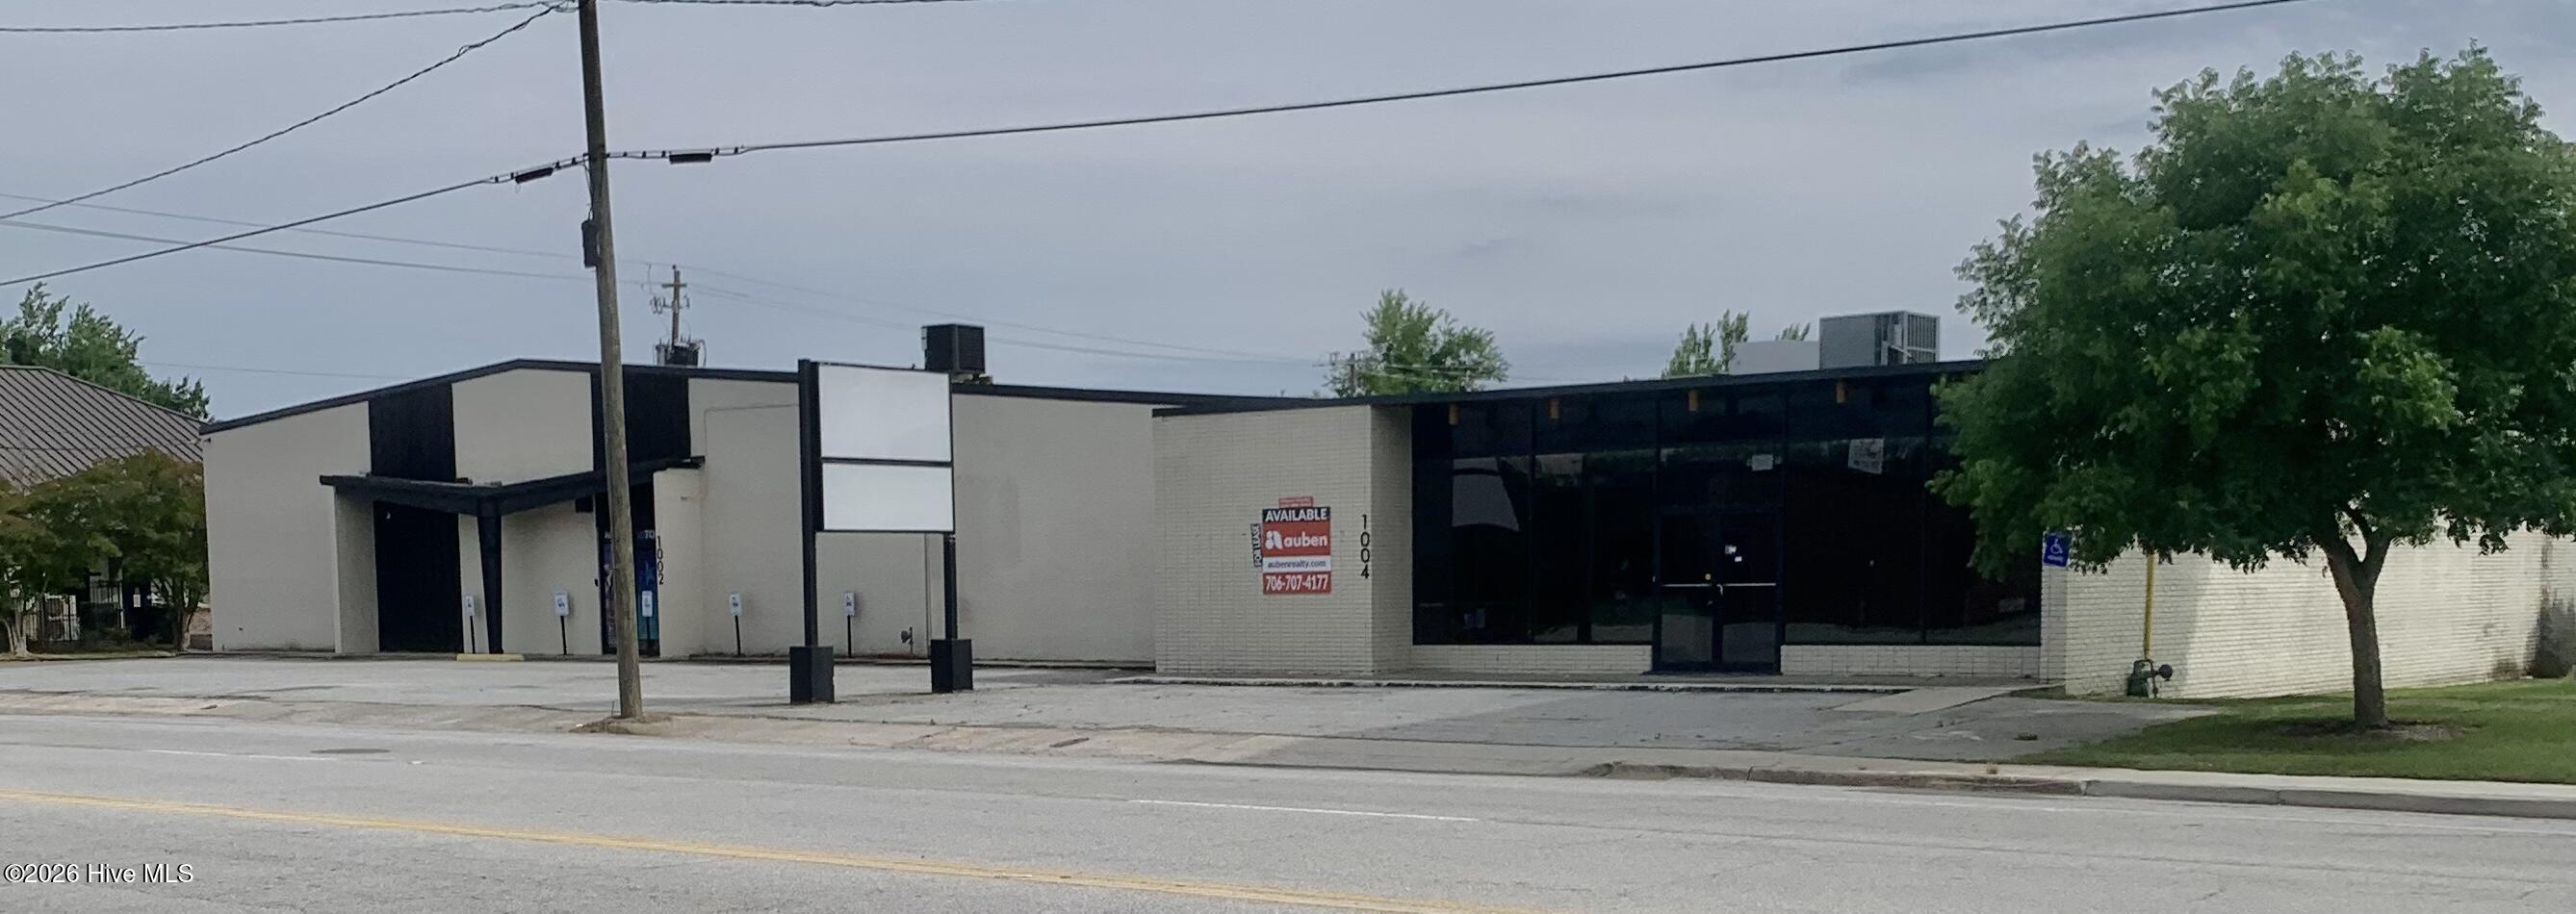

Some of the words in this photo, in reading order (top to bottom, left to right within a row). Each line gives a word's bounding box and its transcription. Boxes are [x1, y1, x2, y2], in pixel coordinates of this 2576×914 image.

[1265, 508, 1327, 521] AVAILABLE
[1283, 531, 1327, 547] auben
[1360, 514, 1370, 578] 1004
[1265, 574, 1328, 592] 706-707-4177
